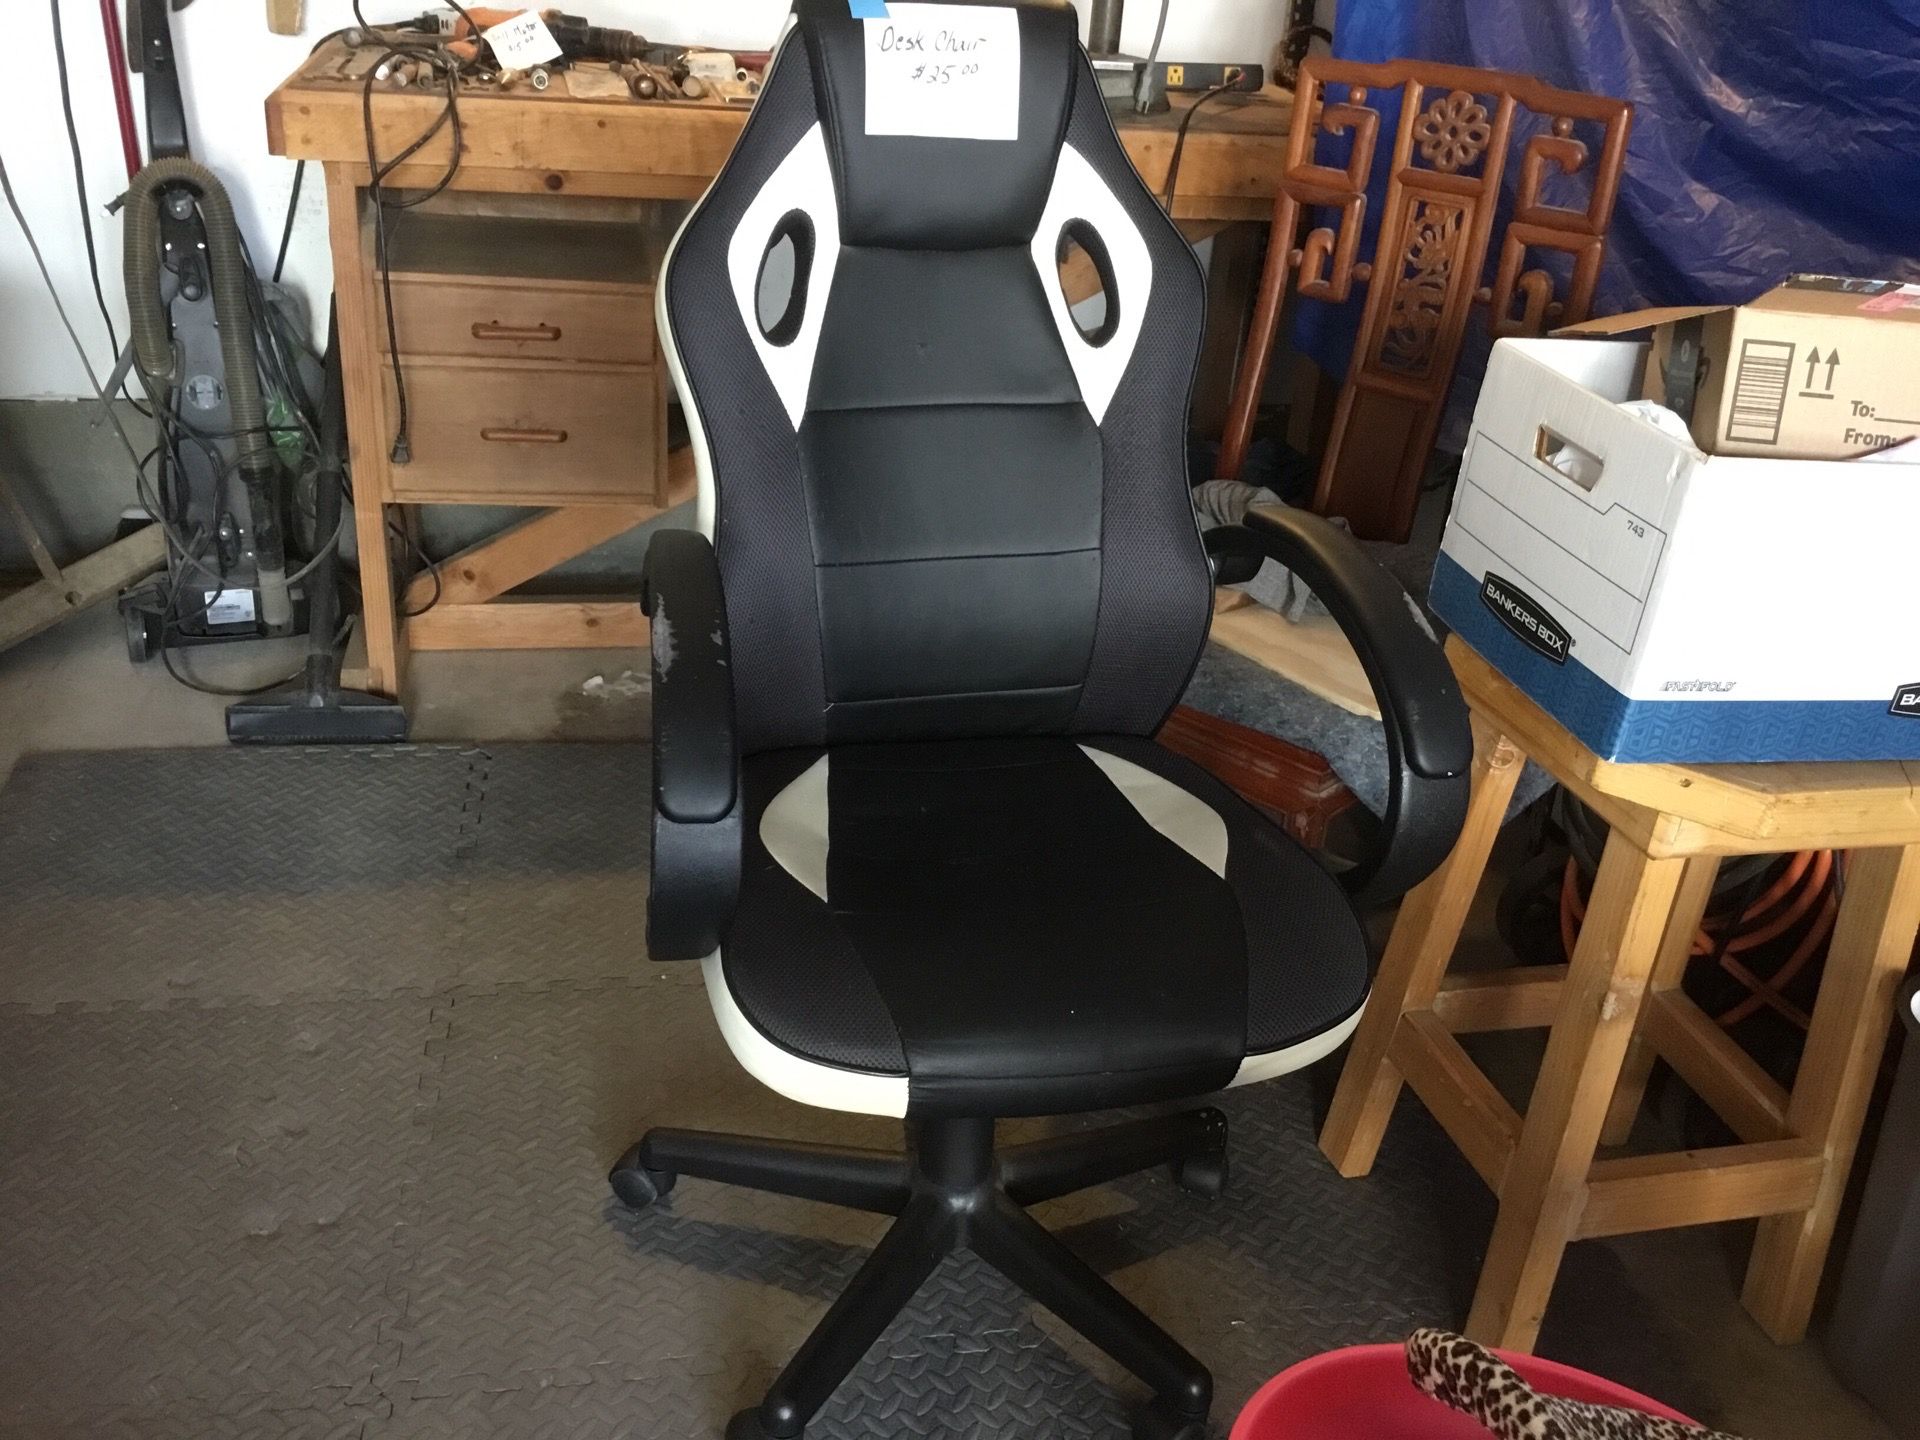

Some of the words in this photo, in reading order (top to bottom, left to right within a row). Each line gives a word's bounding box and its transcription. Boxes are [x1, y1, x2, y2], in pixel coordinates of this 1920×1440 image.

[879, 26, 924, 52] Desk
[935, 30, 987, 52] Chair
[1851, 400, 1876, 418] To:
[1843, 428, 1897, 448] From:
[1627, 520, 1645, 538] 743
[1486, 583, 1538, 632] BANKERS
[1537, 624, 1564, 654] BOX
